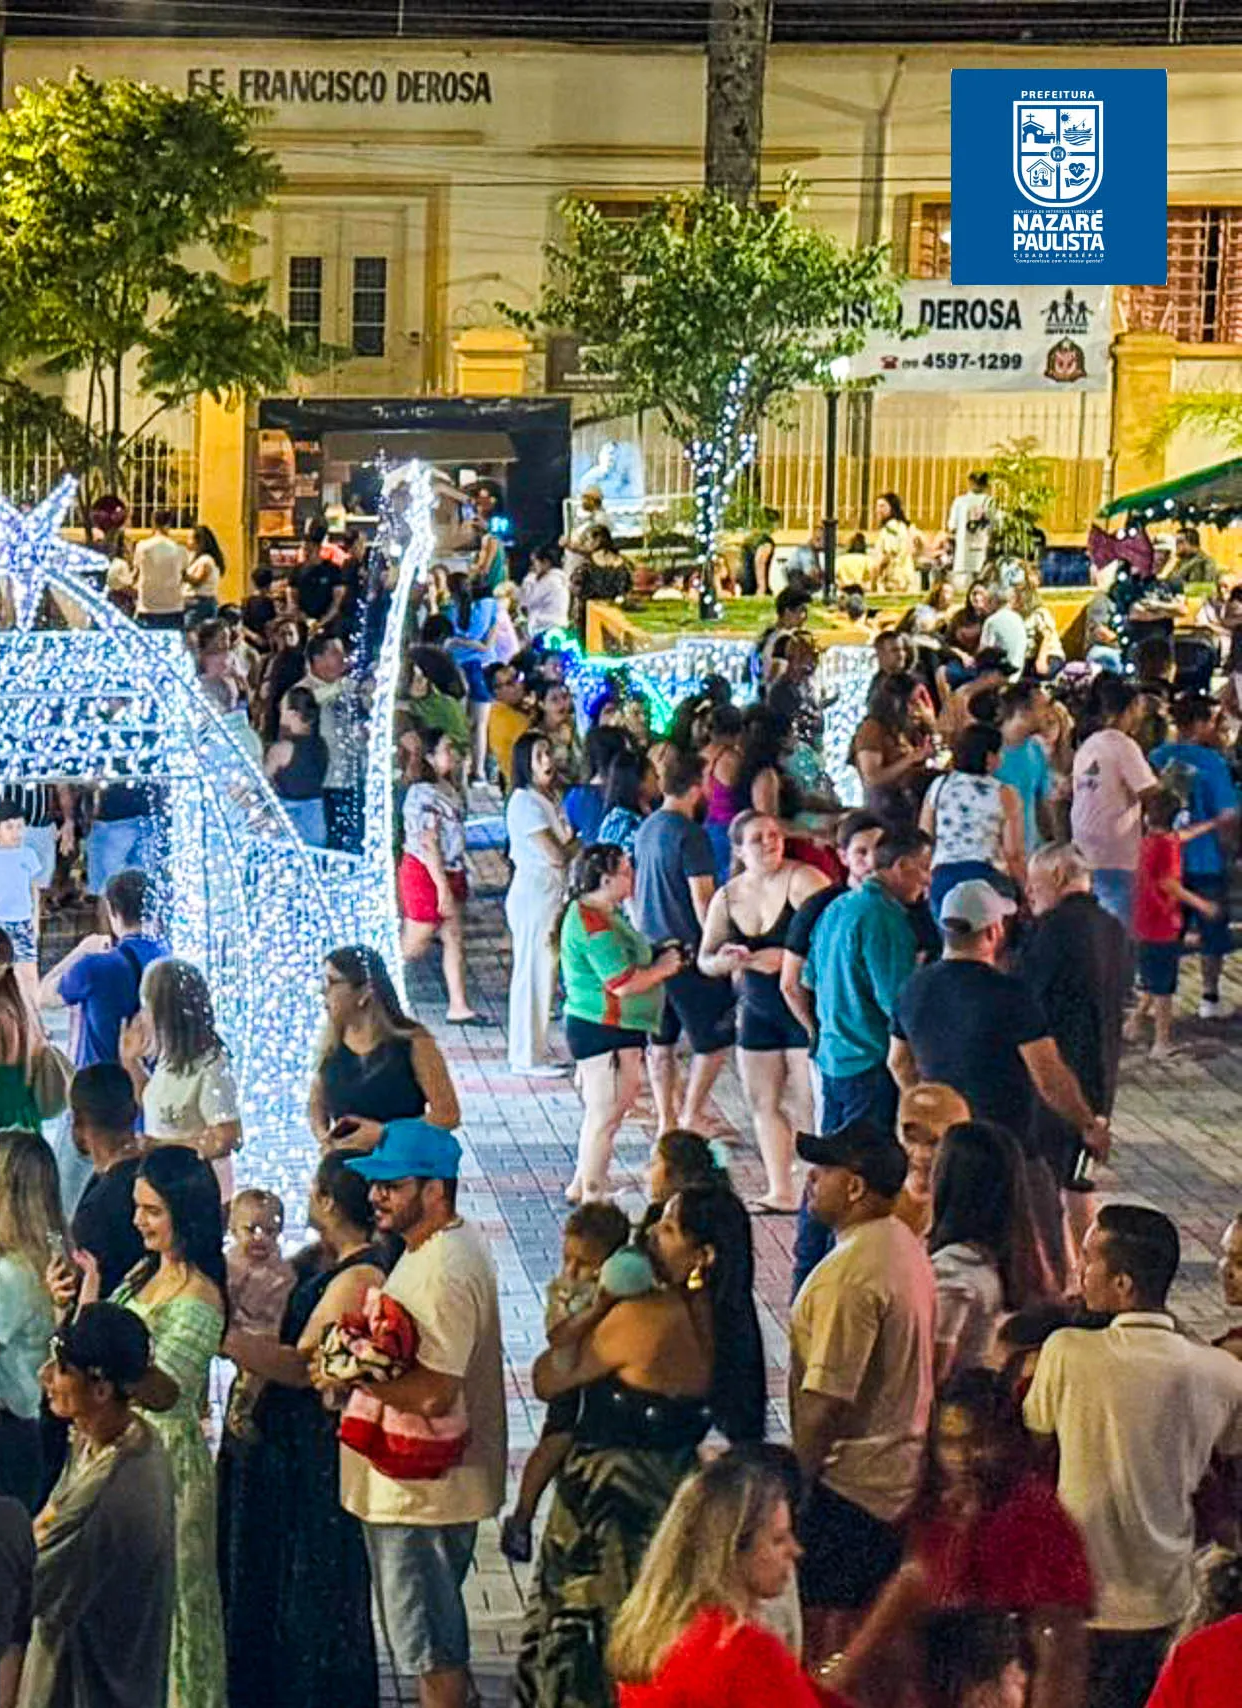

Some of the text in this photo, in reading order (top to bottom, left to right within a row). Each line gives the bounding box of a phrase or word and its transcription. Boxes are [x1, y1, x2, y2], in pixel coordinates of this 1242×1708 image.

[239, 68, 386, 103] FRANCISCO
[397, 71, 492, 103] DEROSA
[919, 298, 1022, 331] DEROSA
[922, 352, 1023, 370] 4597-1299
